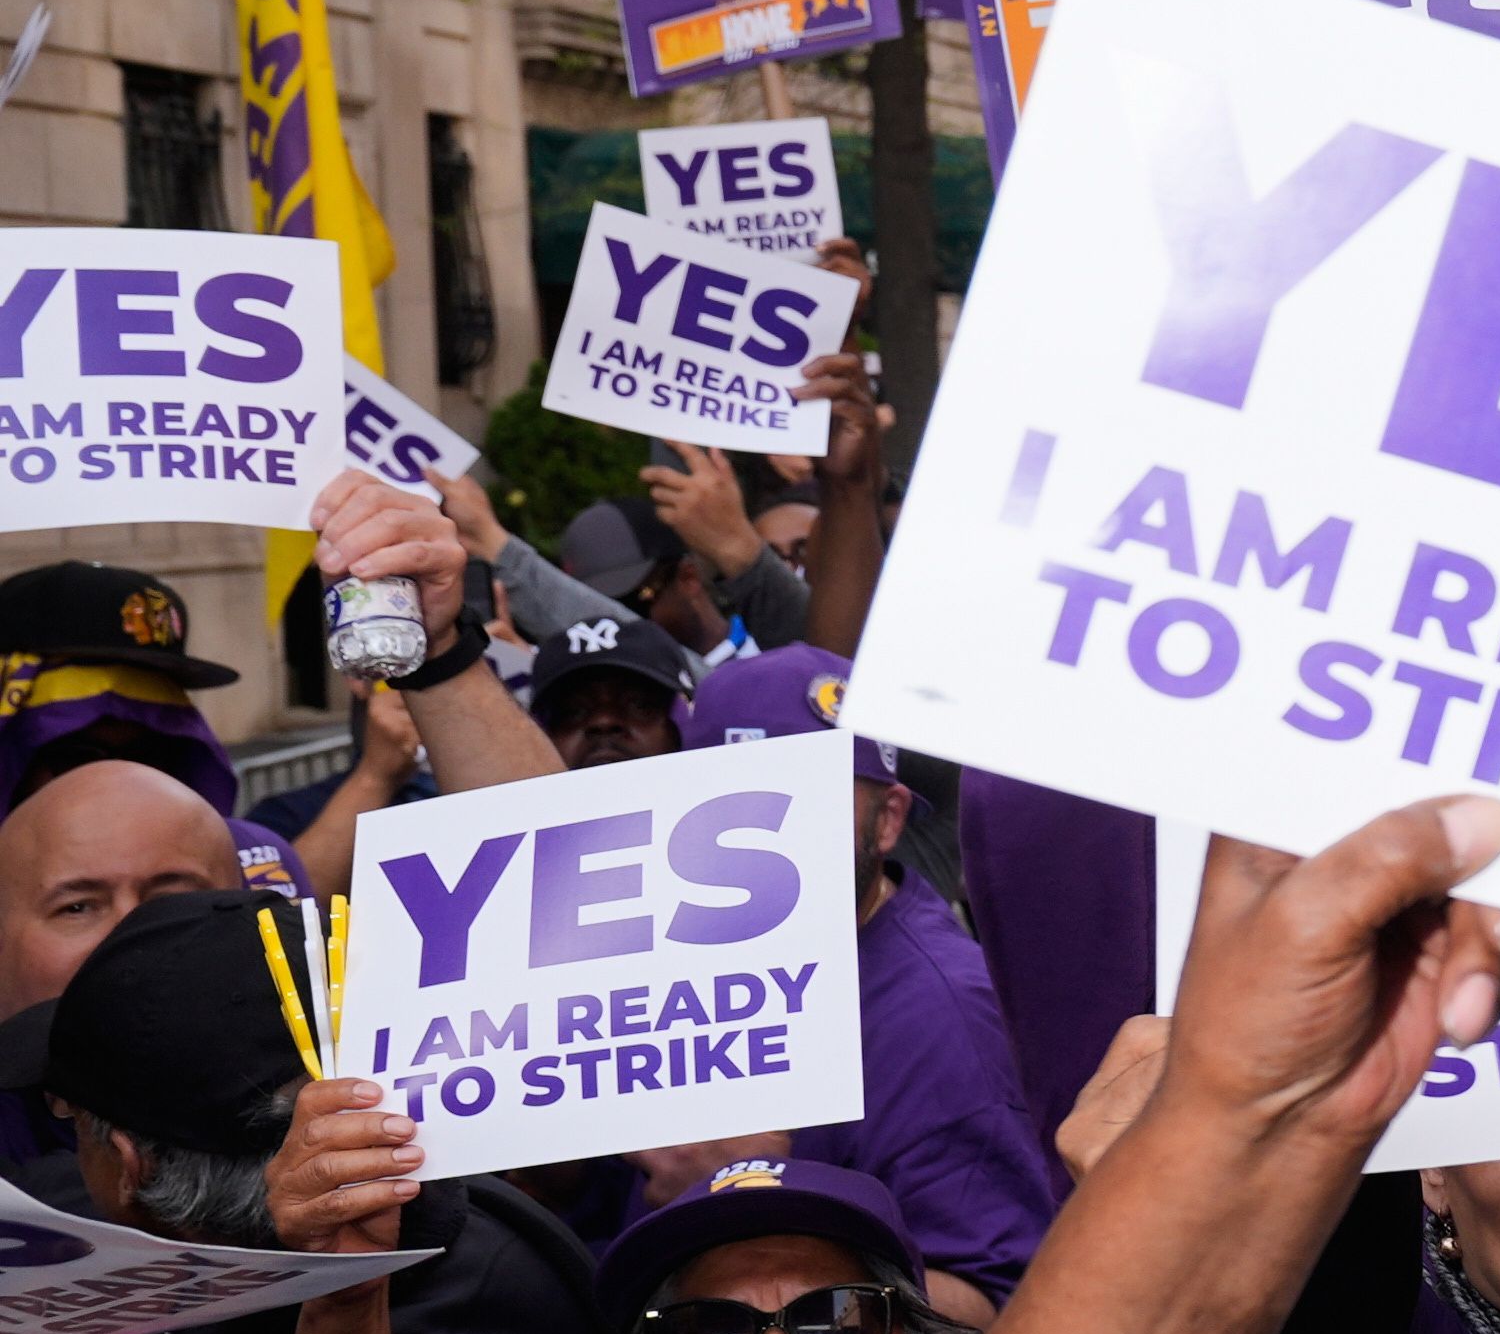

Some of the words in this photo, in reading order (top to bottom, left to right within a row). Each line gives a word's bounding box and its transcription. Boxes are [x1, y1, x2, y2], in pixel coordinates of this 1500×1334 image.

[978, 4, 999, 37] NY
[655, 142, 815, 206] YES
[736, 208, 825, 231] READY
[605, 236, 819, 368] YES
[579, 331, 592, 354] I
[602, 340, 663, 375] AM
[108, 401, 317, 445] READY
[590, 365, 637, 397] TO
[650, 384, 788, 429] STRIKE
[79, 444, 296, 486] STRIKE
[1097, 465, 1355, 614] AM
[1040, 562, 1241, 701] TO
[378, 790, 803, 989] YES
[371, 1027, 391, 1074] I
[409, 1001, 529, 1068] AM
[556, 962, 819, 1045] READY
[392, 1070, 497, 1124] TO
[520, 1024, 792, 1108] STRIKE
